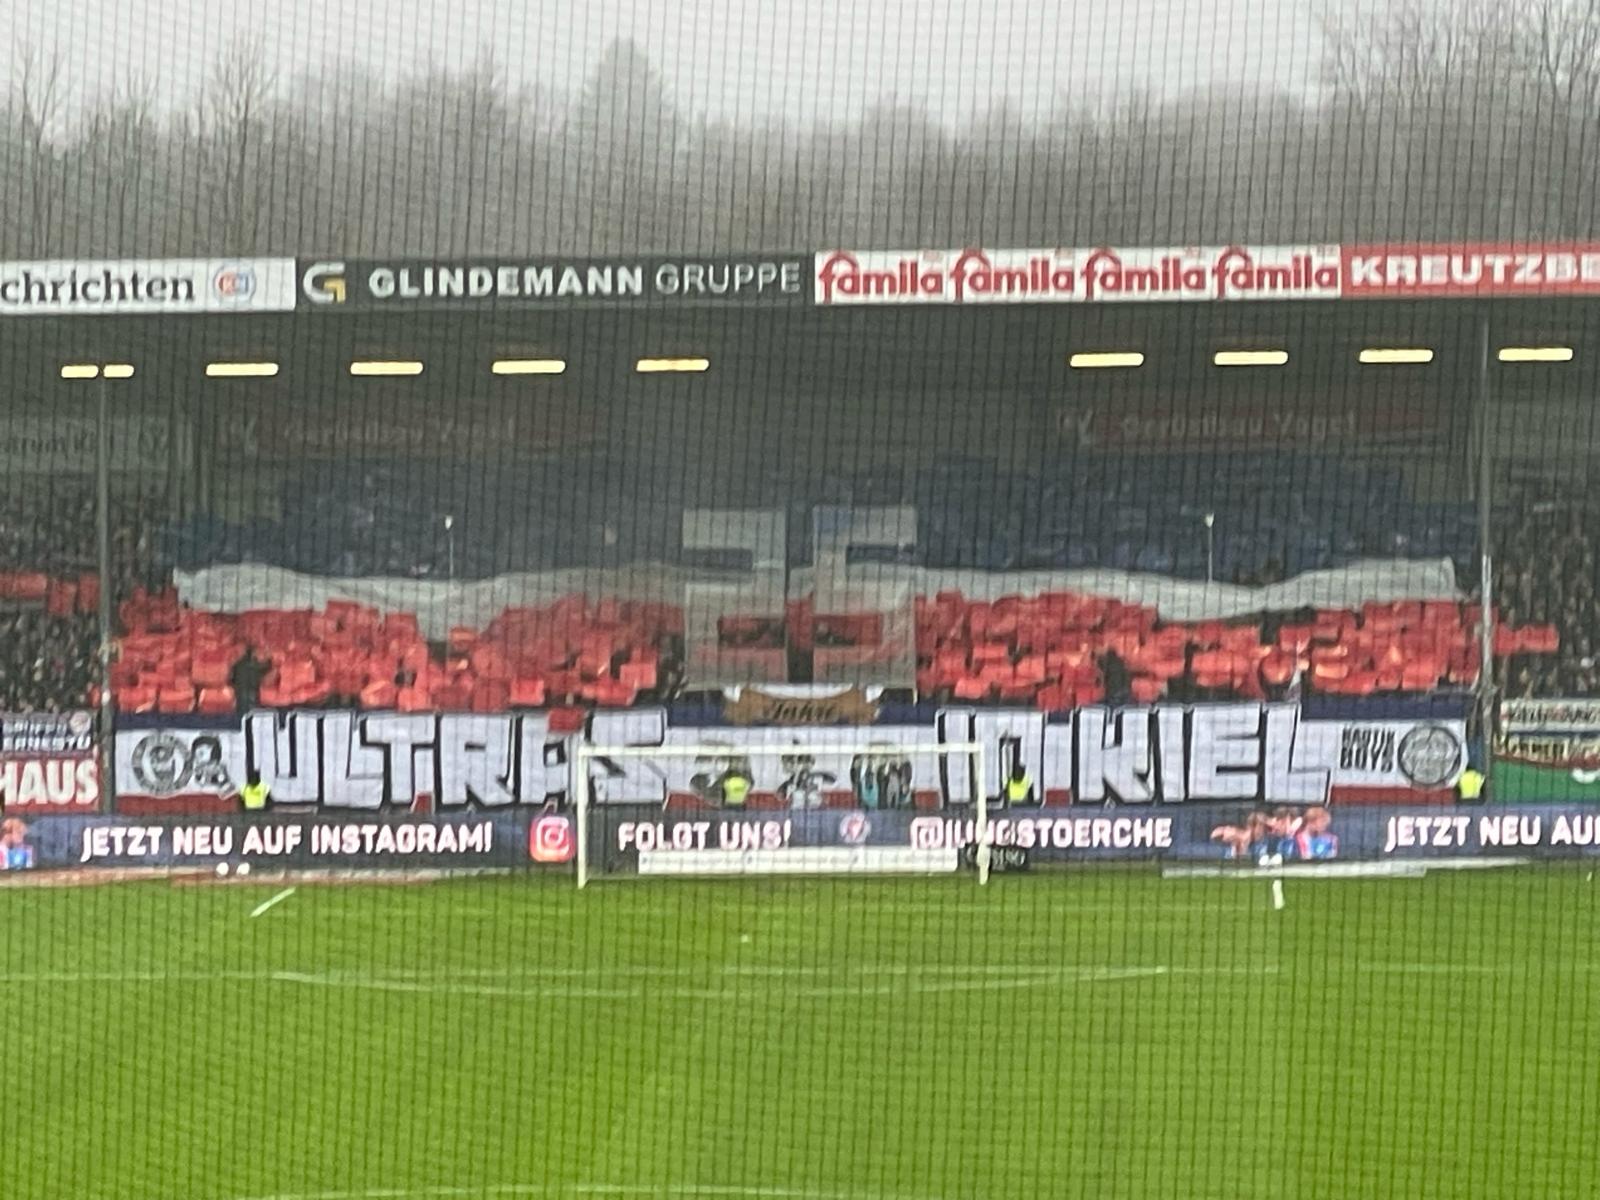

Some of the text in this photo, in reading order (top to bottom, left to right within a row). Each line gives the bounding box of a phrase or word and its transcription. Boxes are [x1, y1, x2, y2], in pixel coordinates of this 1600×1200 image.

[0, 270, 195, 302] chrichten
[368, 262, 801, 298] GLINDEMANN GRUPPE
[819, 250, 943, 304] famila
[950, 247, 1075, 304] famila
[1081, 247, 1206, 301] famila
[1212, 246, 1339, 300] famila
[243, 707, 666, 812] ULTRAS
[1073, 702, 1332, 806] KIEL
[80, 822, 492, 862] JETZT NEU AUF INSTAGRAM!
[618, 819, 791, 852] FOLGT UNS!
[1385, 816, 1470, 852] JETZT
[1479, 816, 1542, 846] NEU
